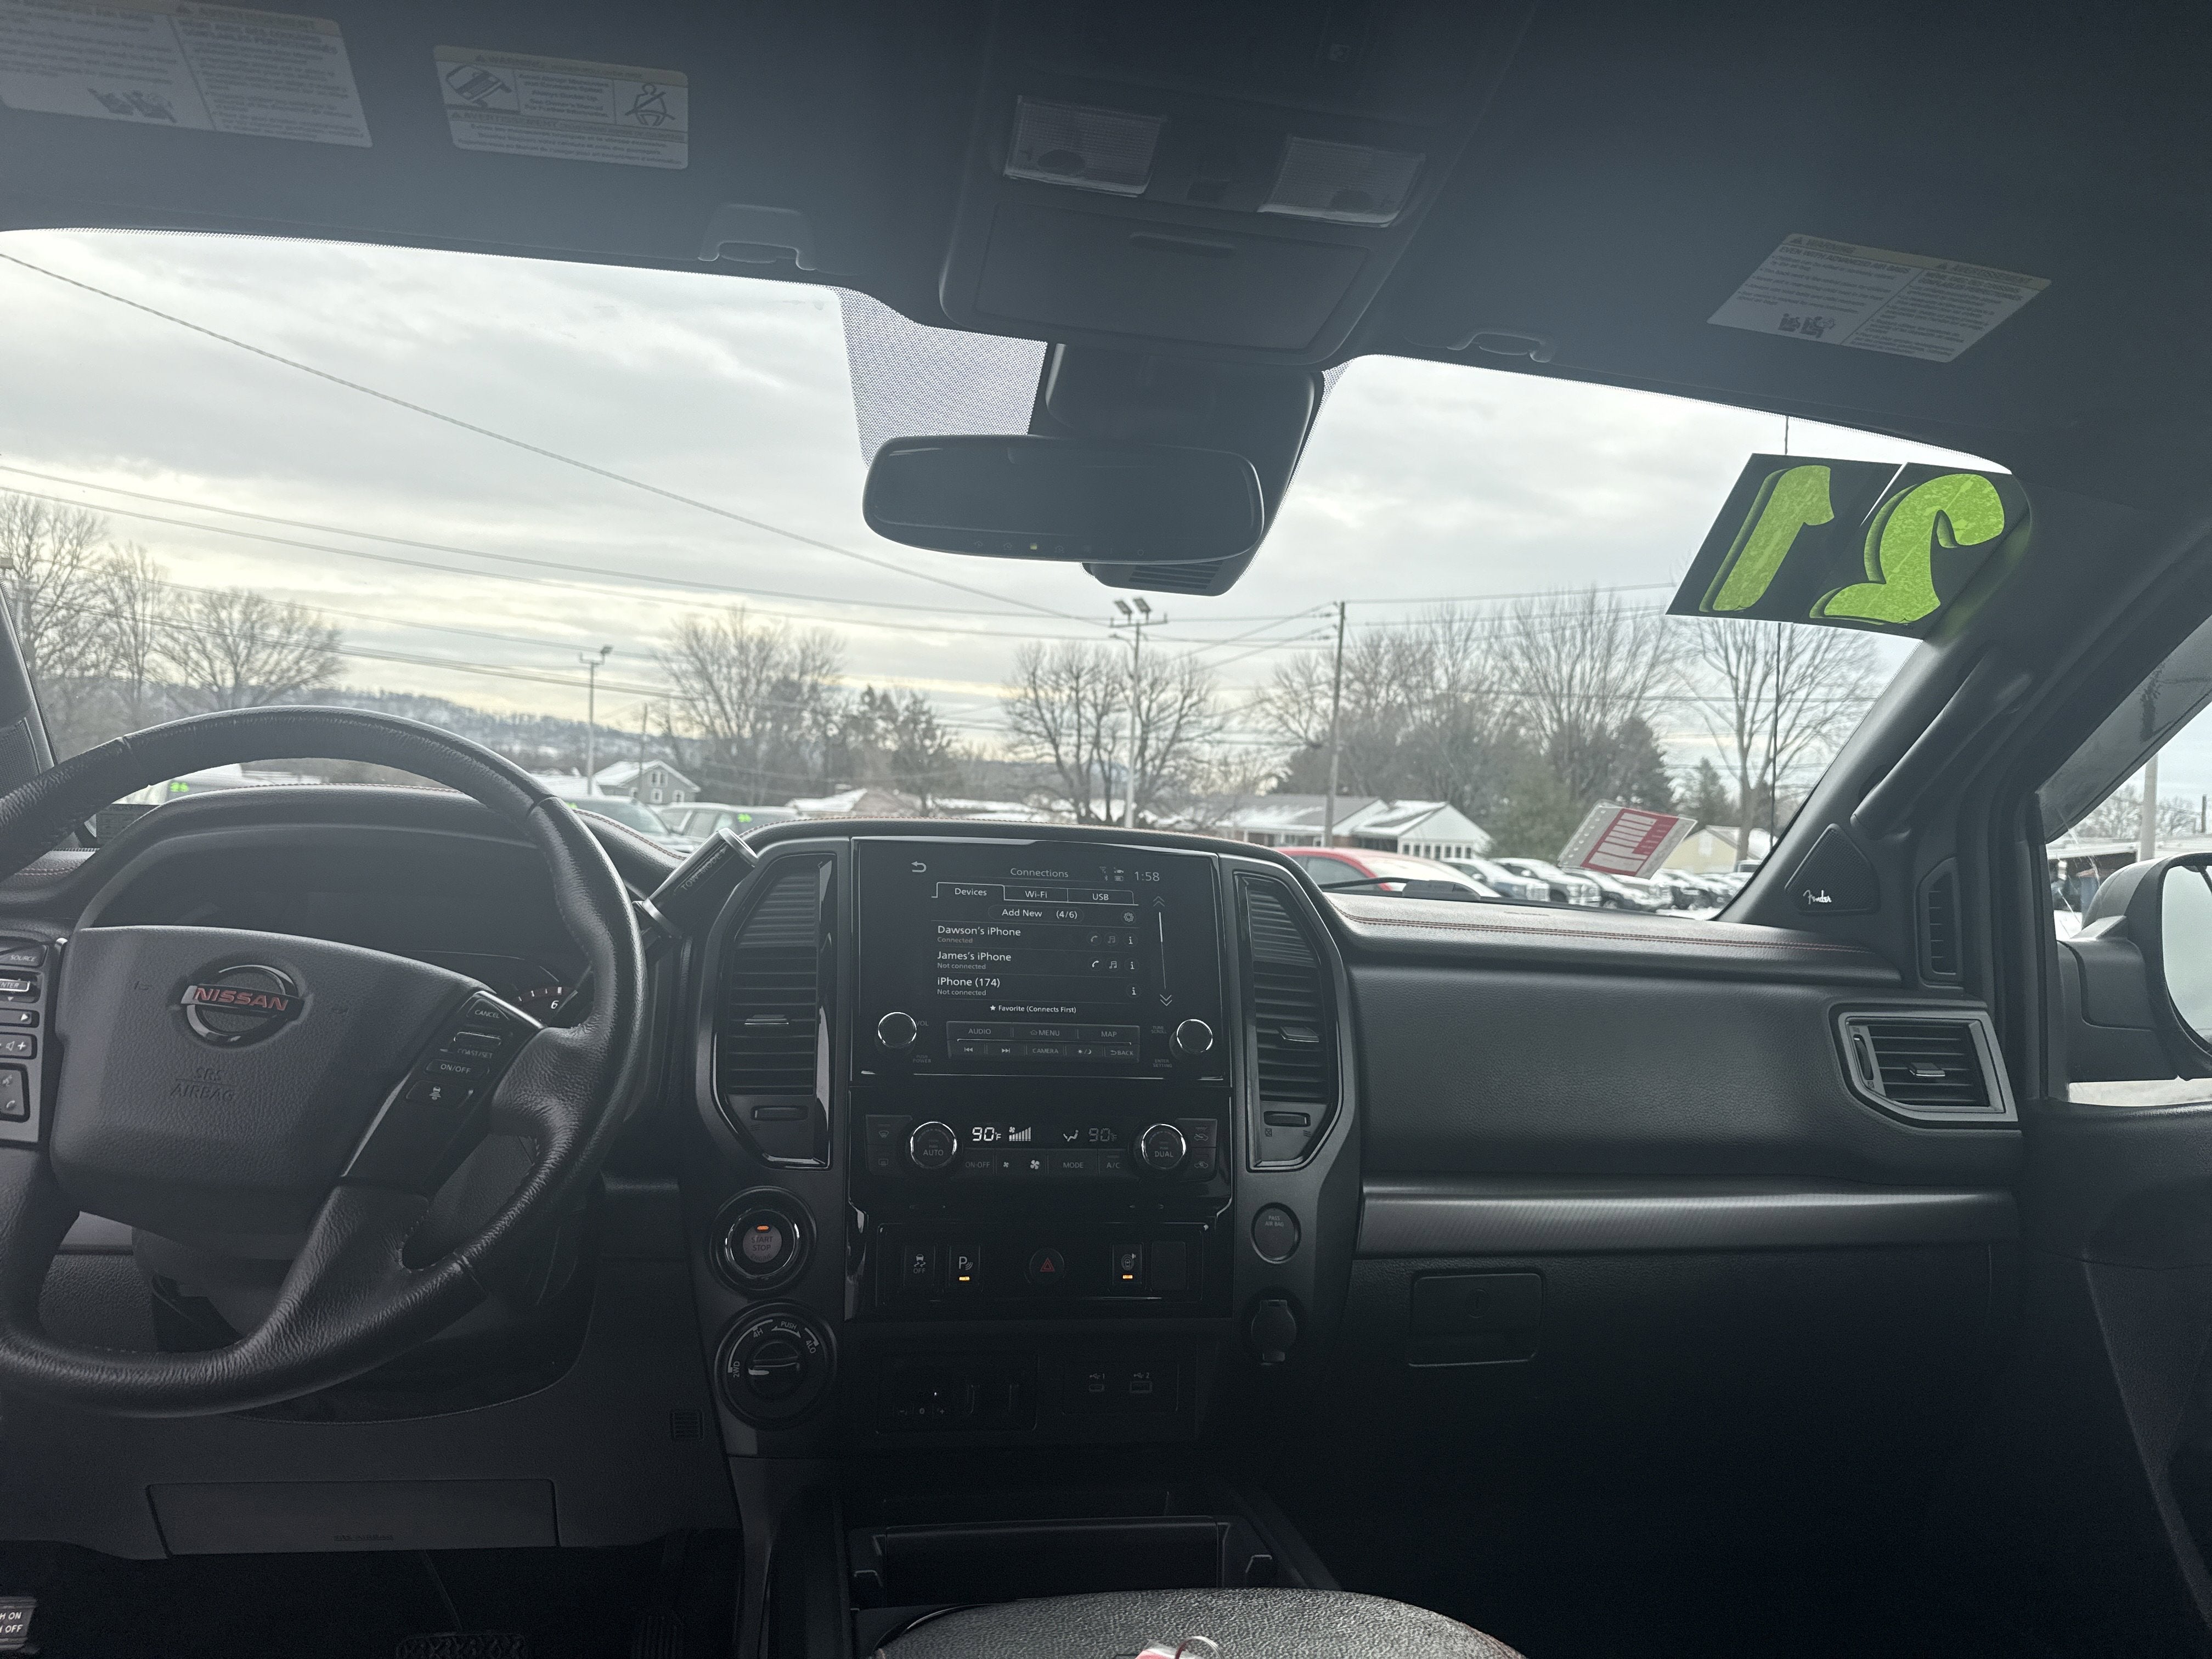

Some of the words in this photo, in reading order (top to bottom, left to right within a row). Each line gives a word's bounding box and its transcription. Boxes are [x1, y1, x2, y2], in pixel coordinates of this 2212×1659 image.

[1010, 867, 1069, 878] Connections
[1134, 871, 1160, 882] 1:58
[955, 888, 987, 896] Devices
[1025, 890, 1047, 899] Wi-Fi
[1092, 893, 1109, 901] USB
[1803, 889, 1832, 905] Fender
[1001, 909, 1020, 917] Add
[1023, 909, 1042, 917] New
[1056, 910, 1077, 919] (4/6)
[938, 925, 985, 935] Dawson's
[987, 927, 1021, 936] iPhone
[937, 951, 974, 961] James's
[977, 952, 1012, 962] iPhone
[937, 977, 973, 986] iPhone
[975, 977, 1001, 988] (174)
[194, 987, 288, 1011] NISSAN
[551, 1000, 560, 1009] 6
[475, 1009, 500, 1019] CANCEL
[1026, 1005, 1059, 1013] (Connects
[1060, 1006, 1076, 1014] First)
[441, 1064, 471, 1074] ON/OFF
[170, 1084, 236, 1102] AIRBAG
[781, 1321, 797, 1330] PUSH
[752, 1328, 764, 1339] 4H
[805, 1339, 817, 1355] 4LO
[732, 1361, 741, 1378] 2WD
[8, 1612, 22, 1620] ON
[5, 1624, 23, 1633] OFF
